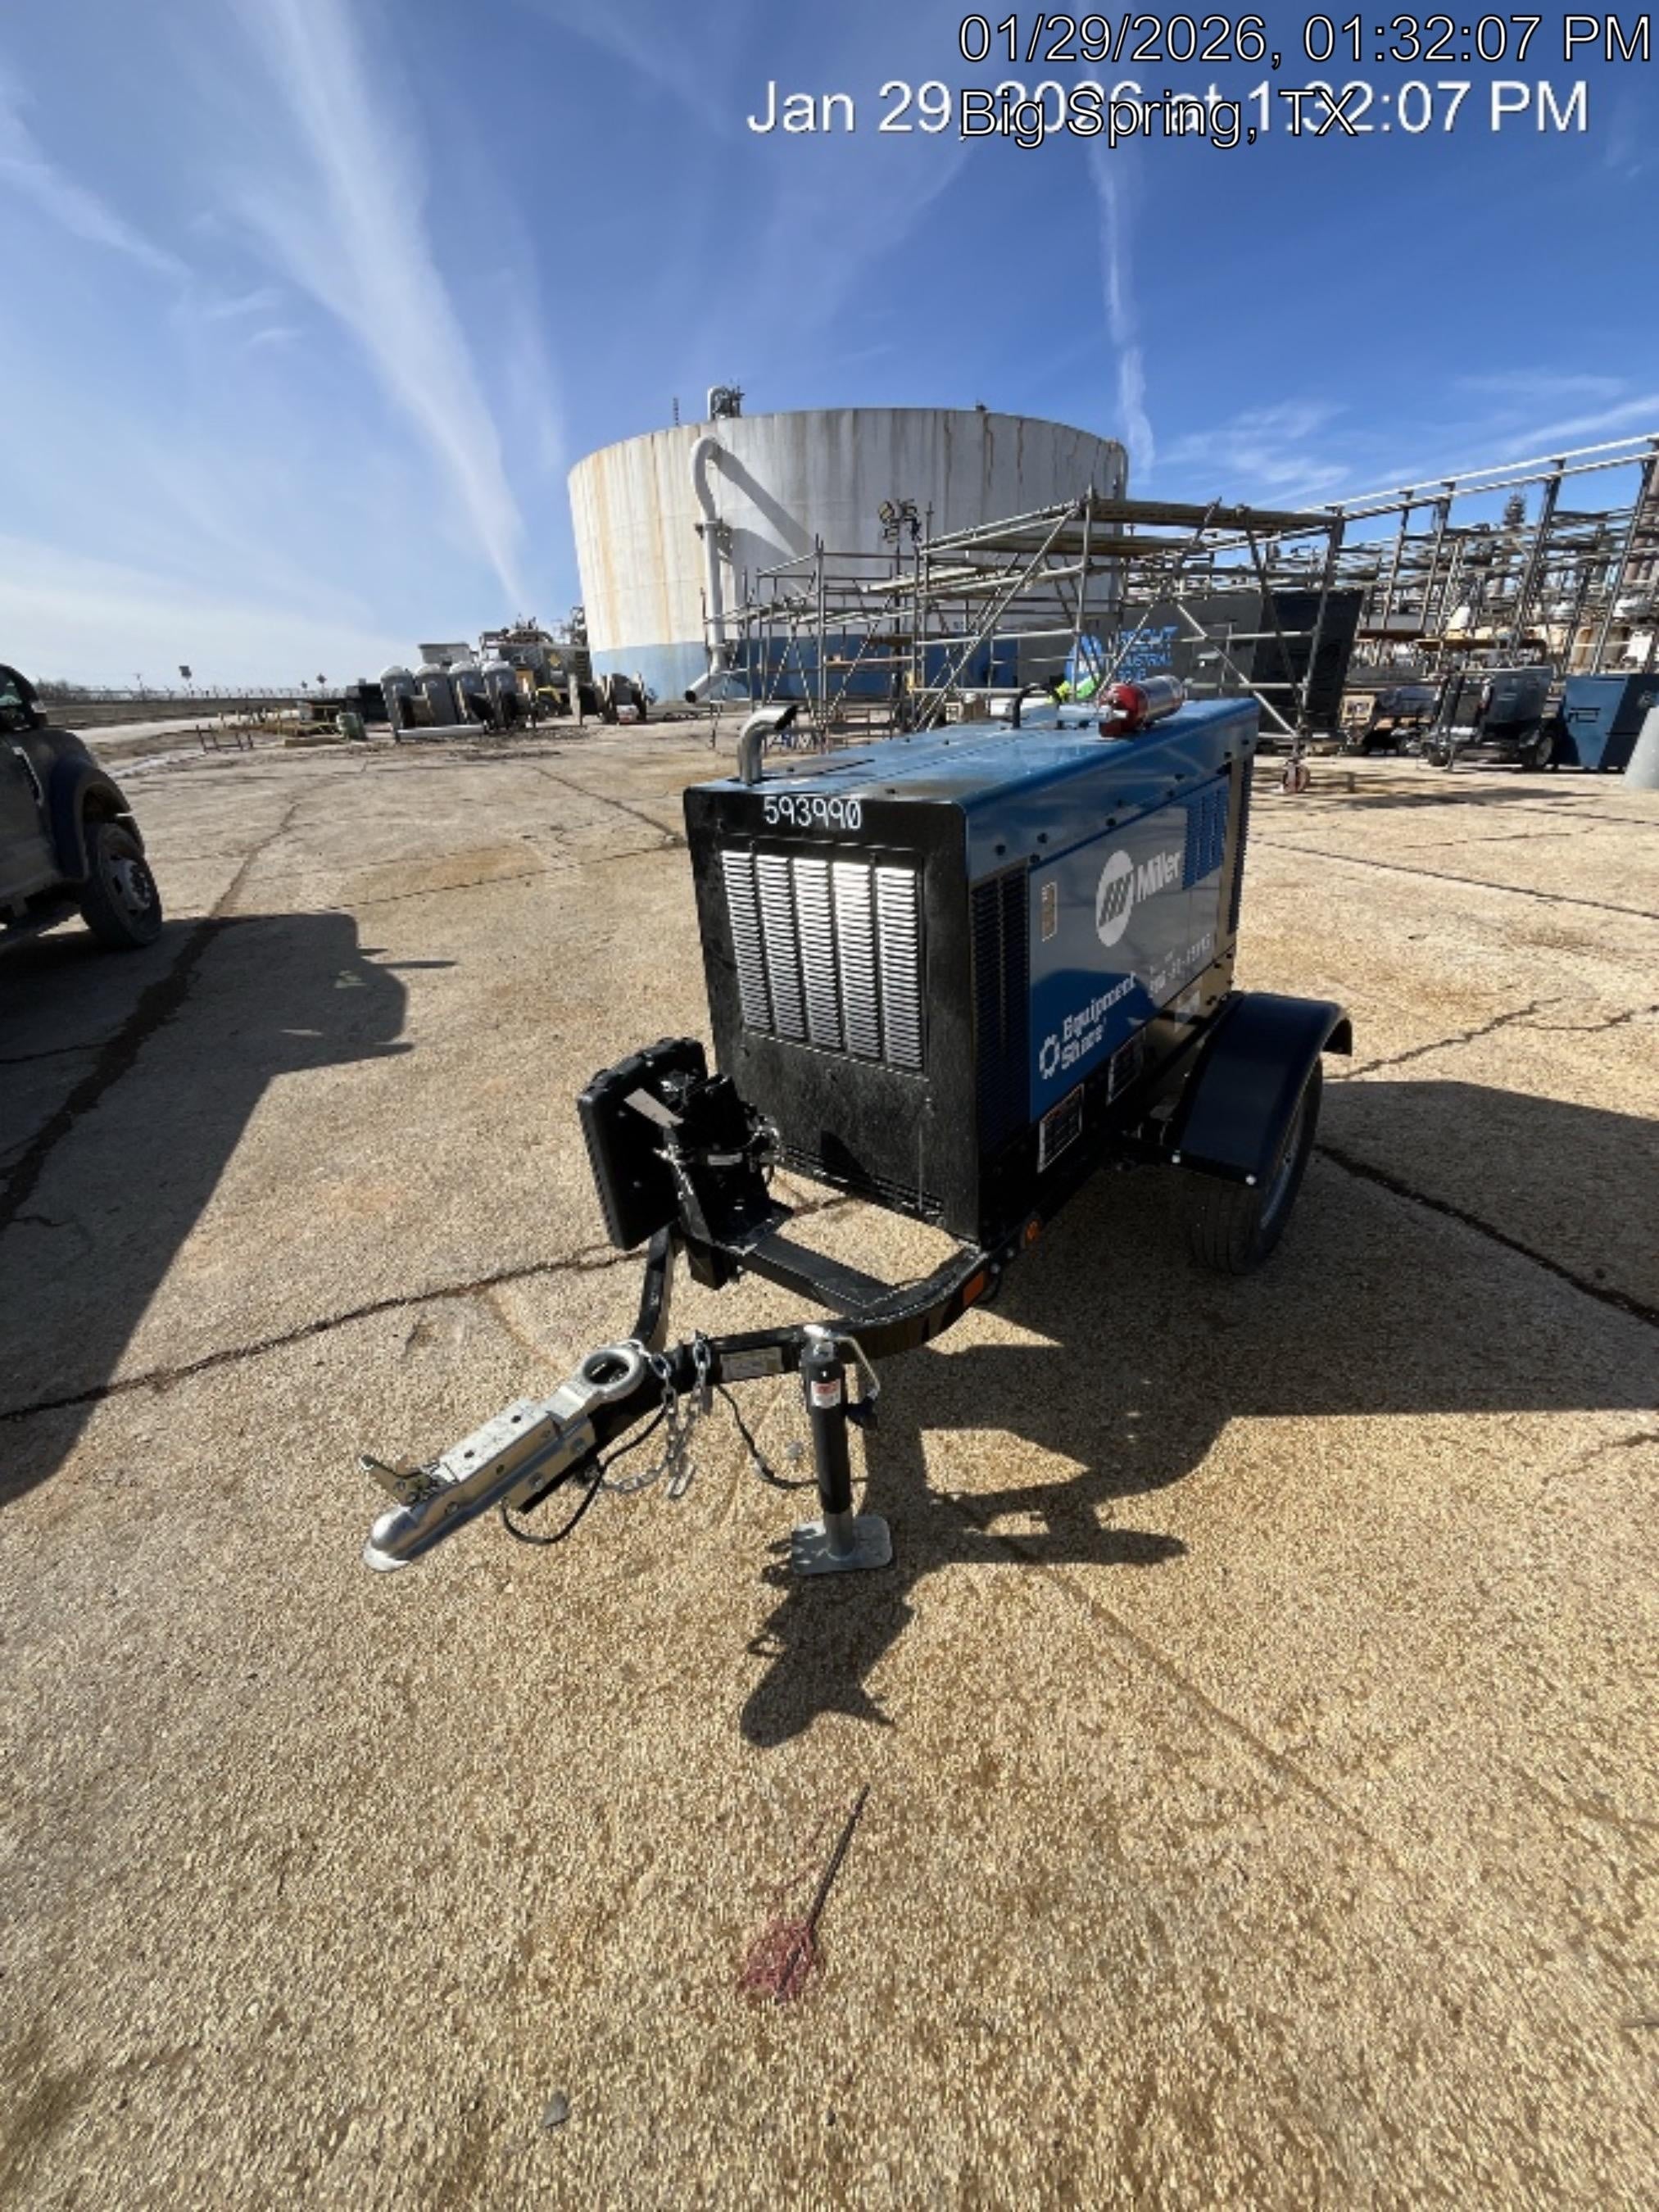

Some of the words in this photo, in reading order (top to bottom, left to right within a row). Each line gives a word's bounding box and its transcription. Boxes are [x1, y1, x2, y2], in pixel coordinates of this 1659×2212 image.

[764, 796, 862, 830] 593990
[1137, 851, 1181, 903] Miller
[1063, 971, 1136, 1041] Equipment
